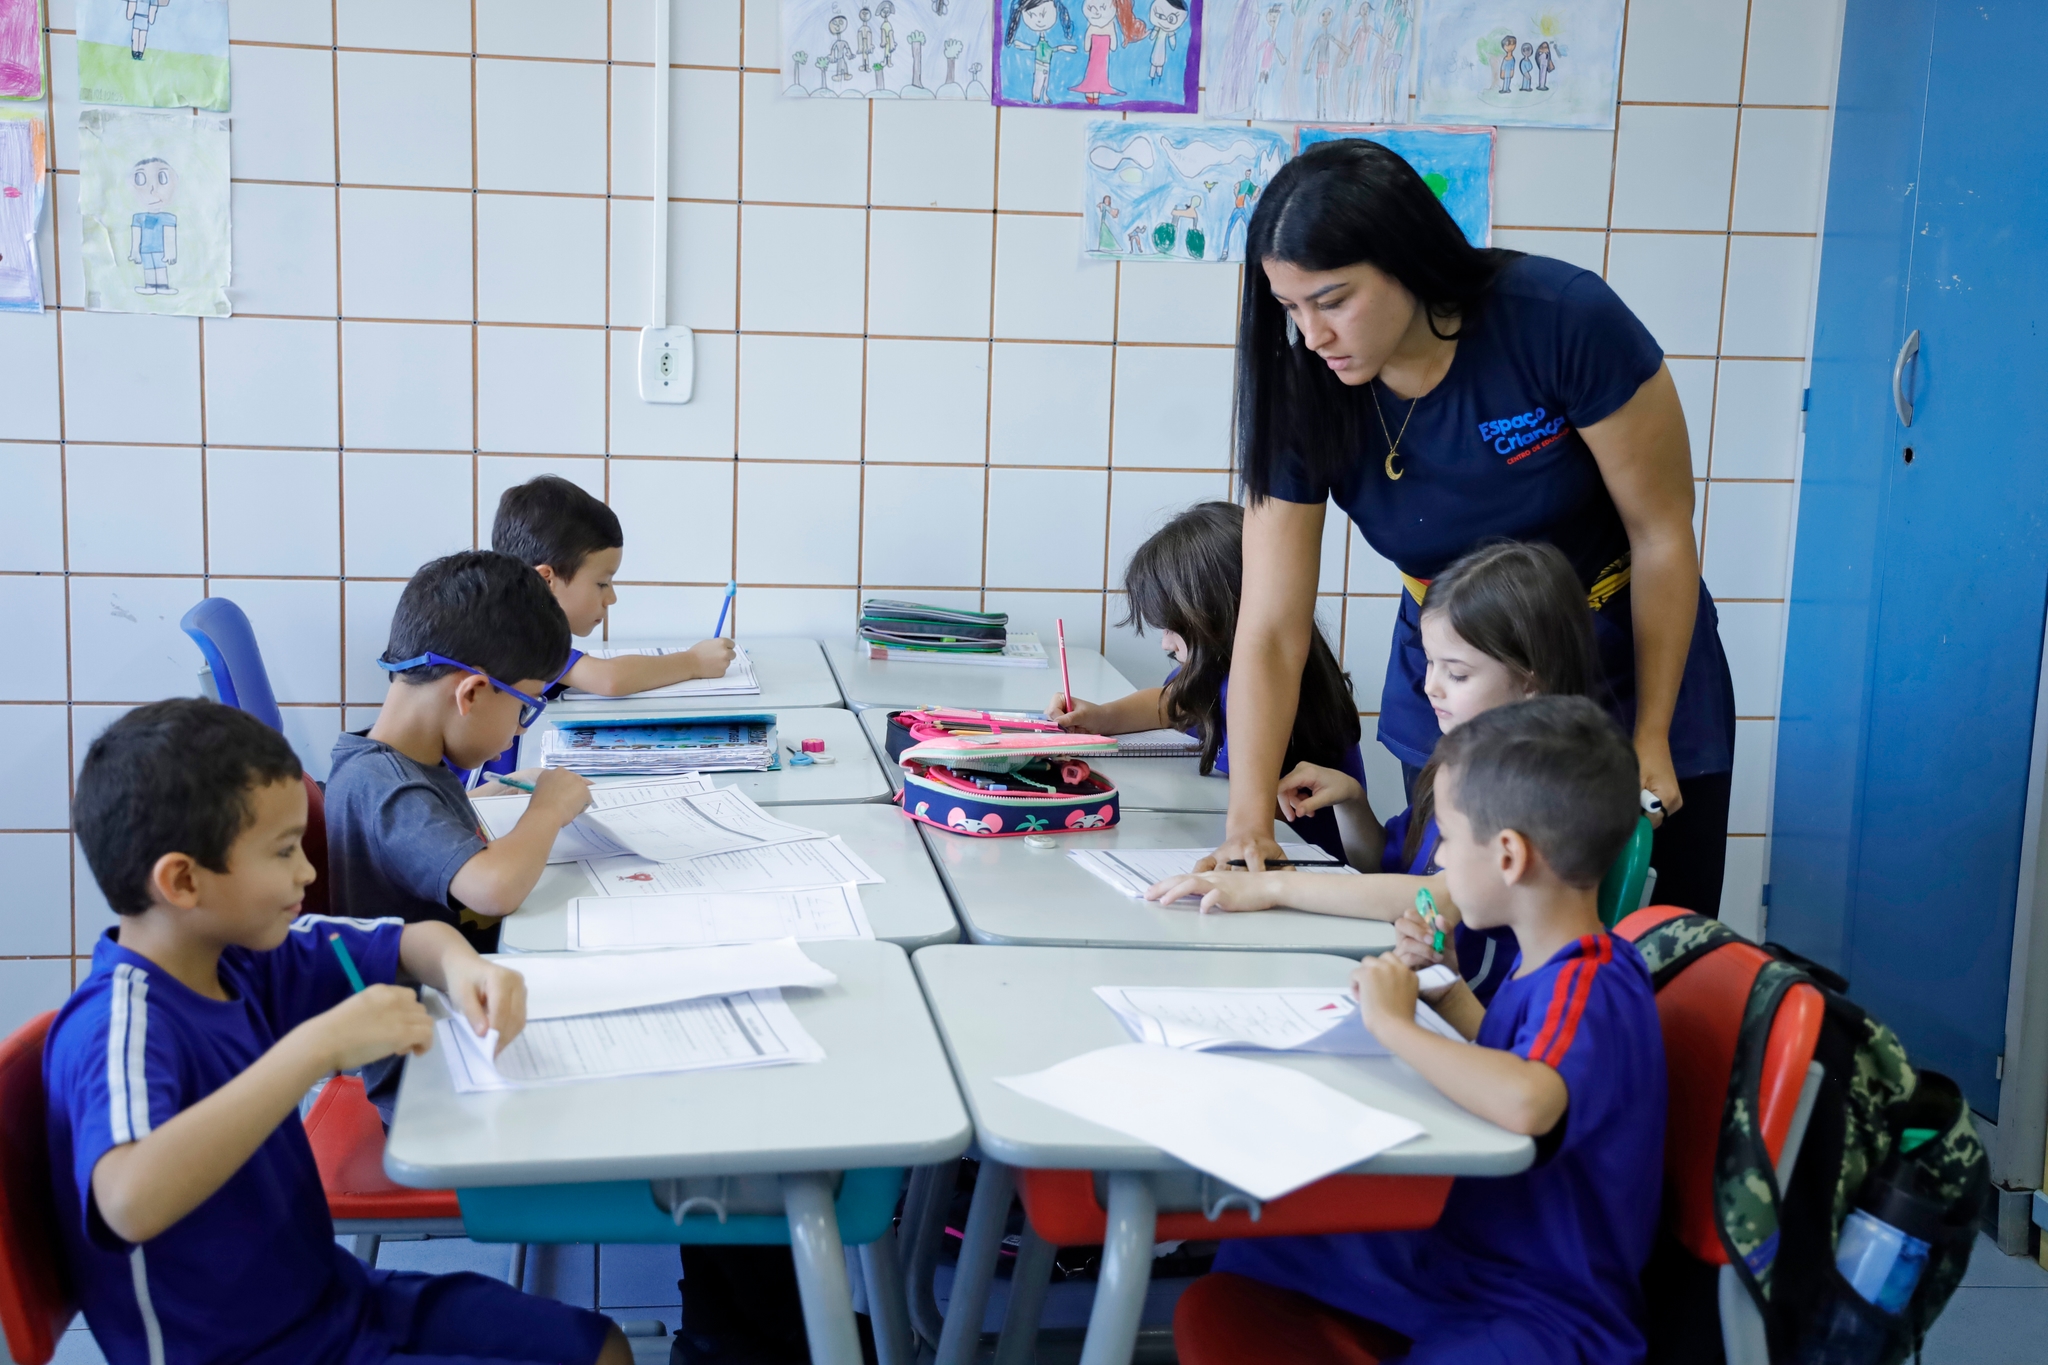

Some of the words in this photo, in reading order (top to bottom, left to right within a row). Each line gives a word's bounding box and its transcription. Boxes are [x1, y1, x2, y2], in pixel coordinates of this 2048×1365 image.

[1478, 407, 1545, 442] Espaço
[1494, 416, 1566, 455] Criança
[1506, 450, 1531, 465] CENTRO
[1531, 444, 1542, 453] DE
